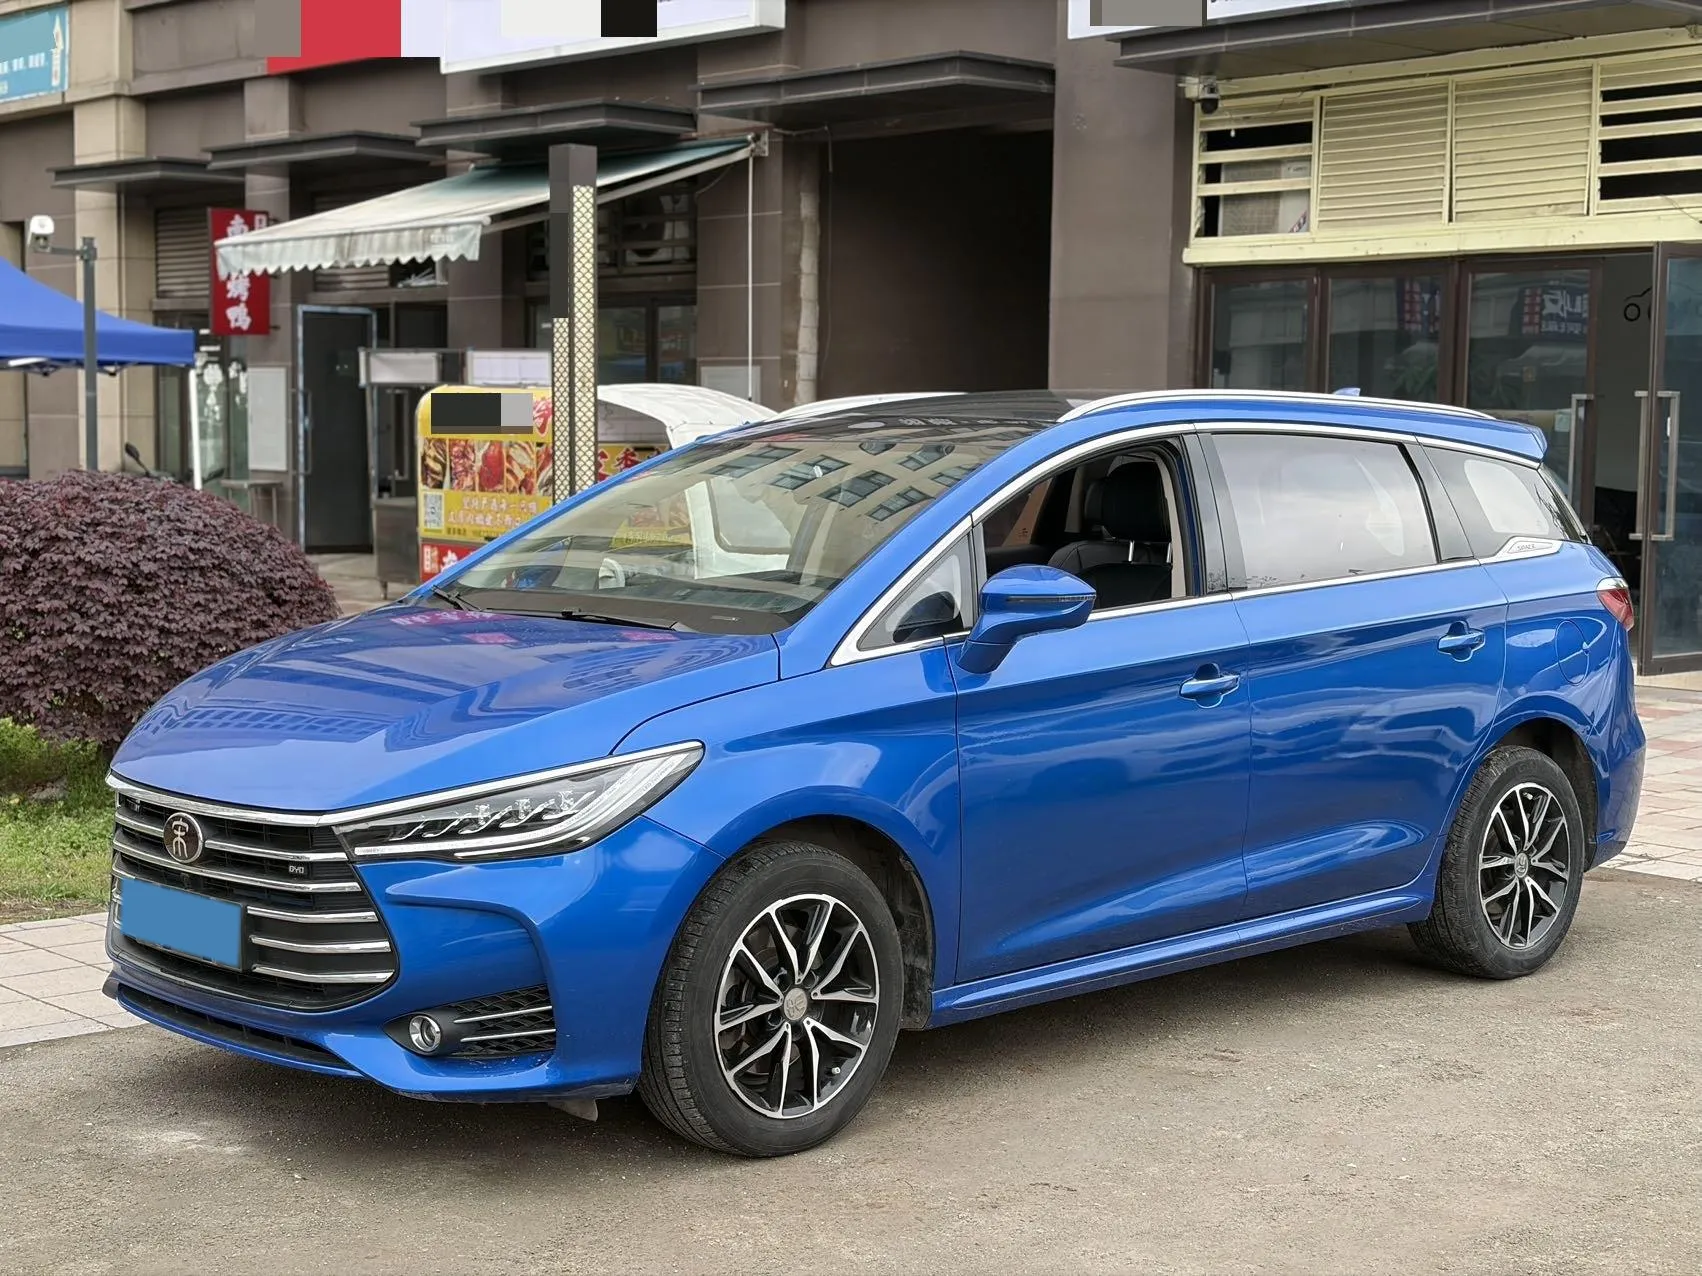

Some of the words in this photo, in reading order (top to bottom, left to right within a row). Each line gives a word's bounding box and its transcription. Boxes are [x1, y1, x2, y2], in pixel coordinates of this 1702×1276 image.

[226, 213, 252, 331] 南烤鸭
[288, 865, 305, 874] BYD
